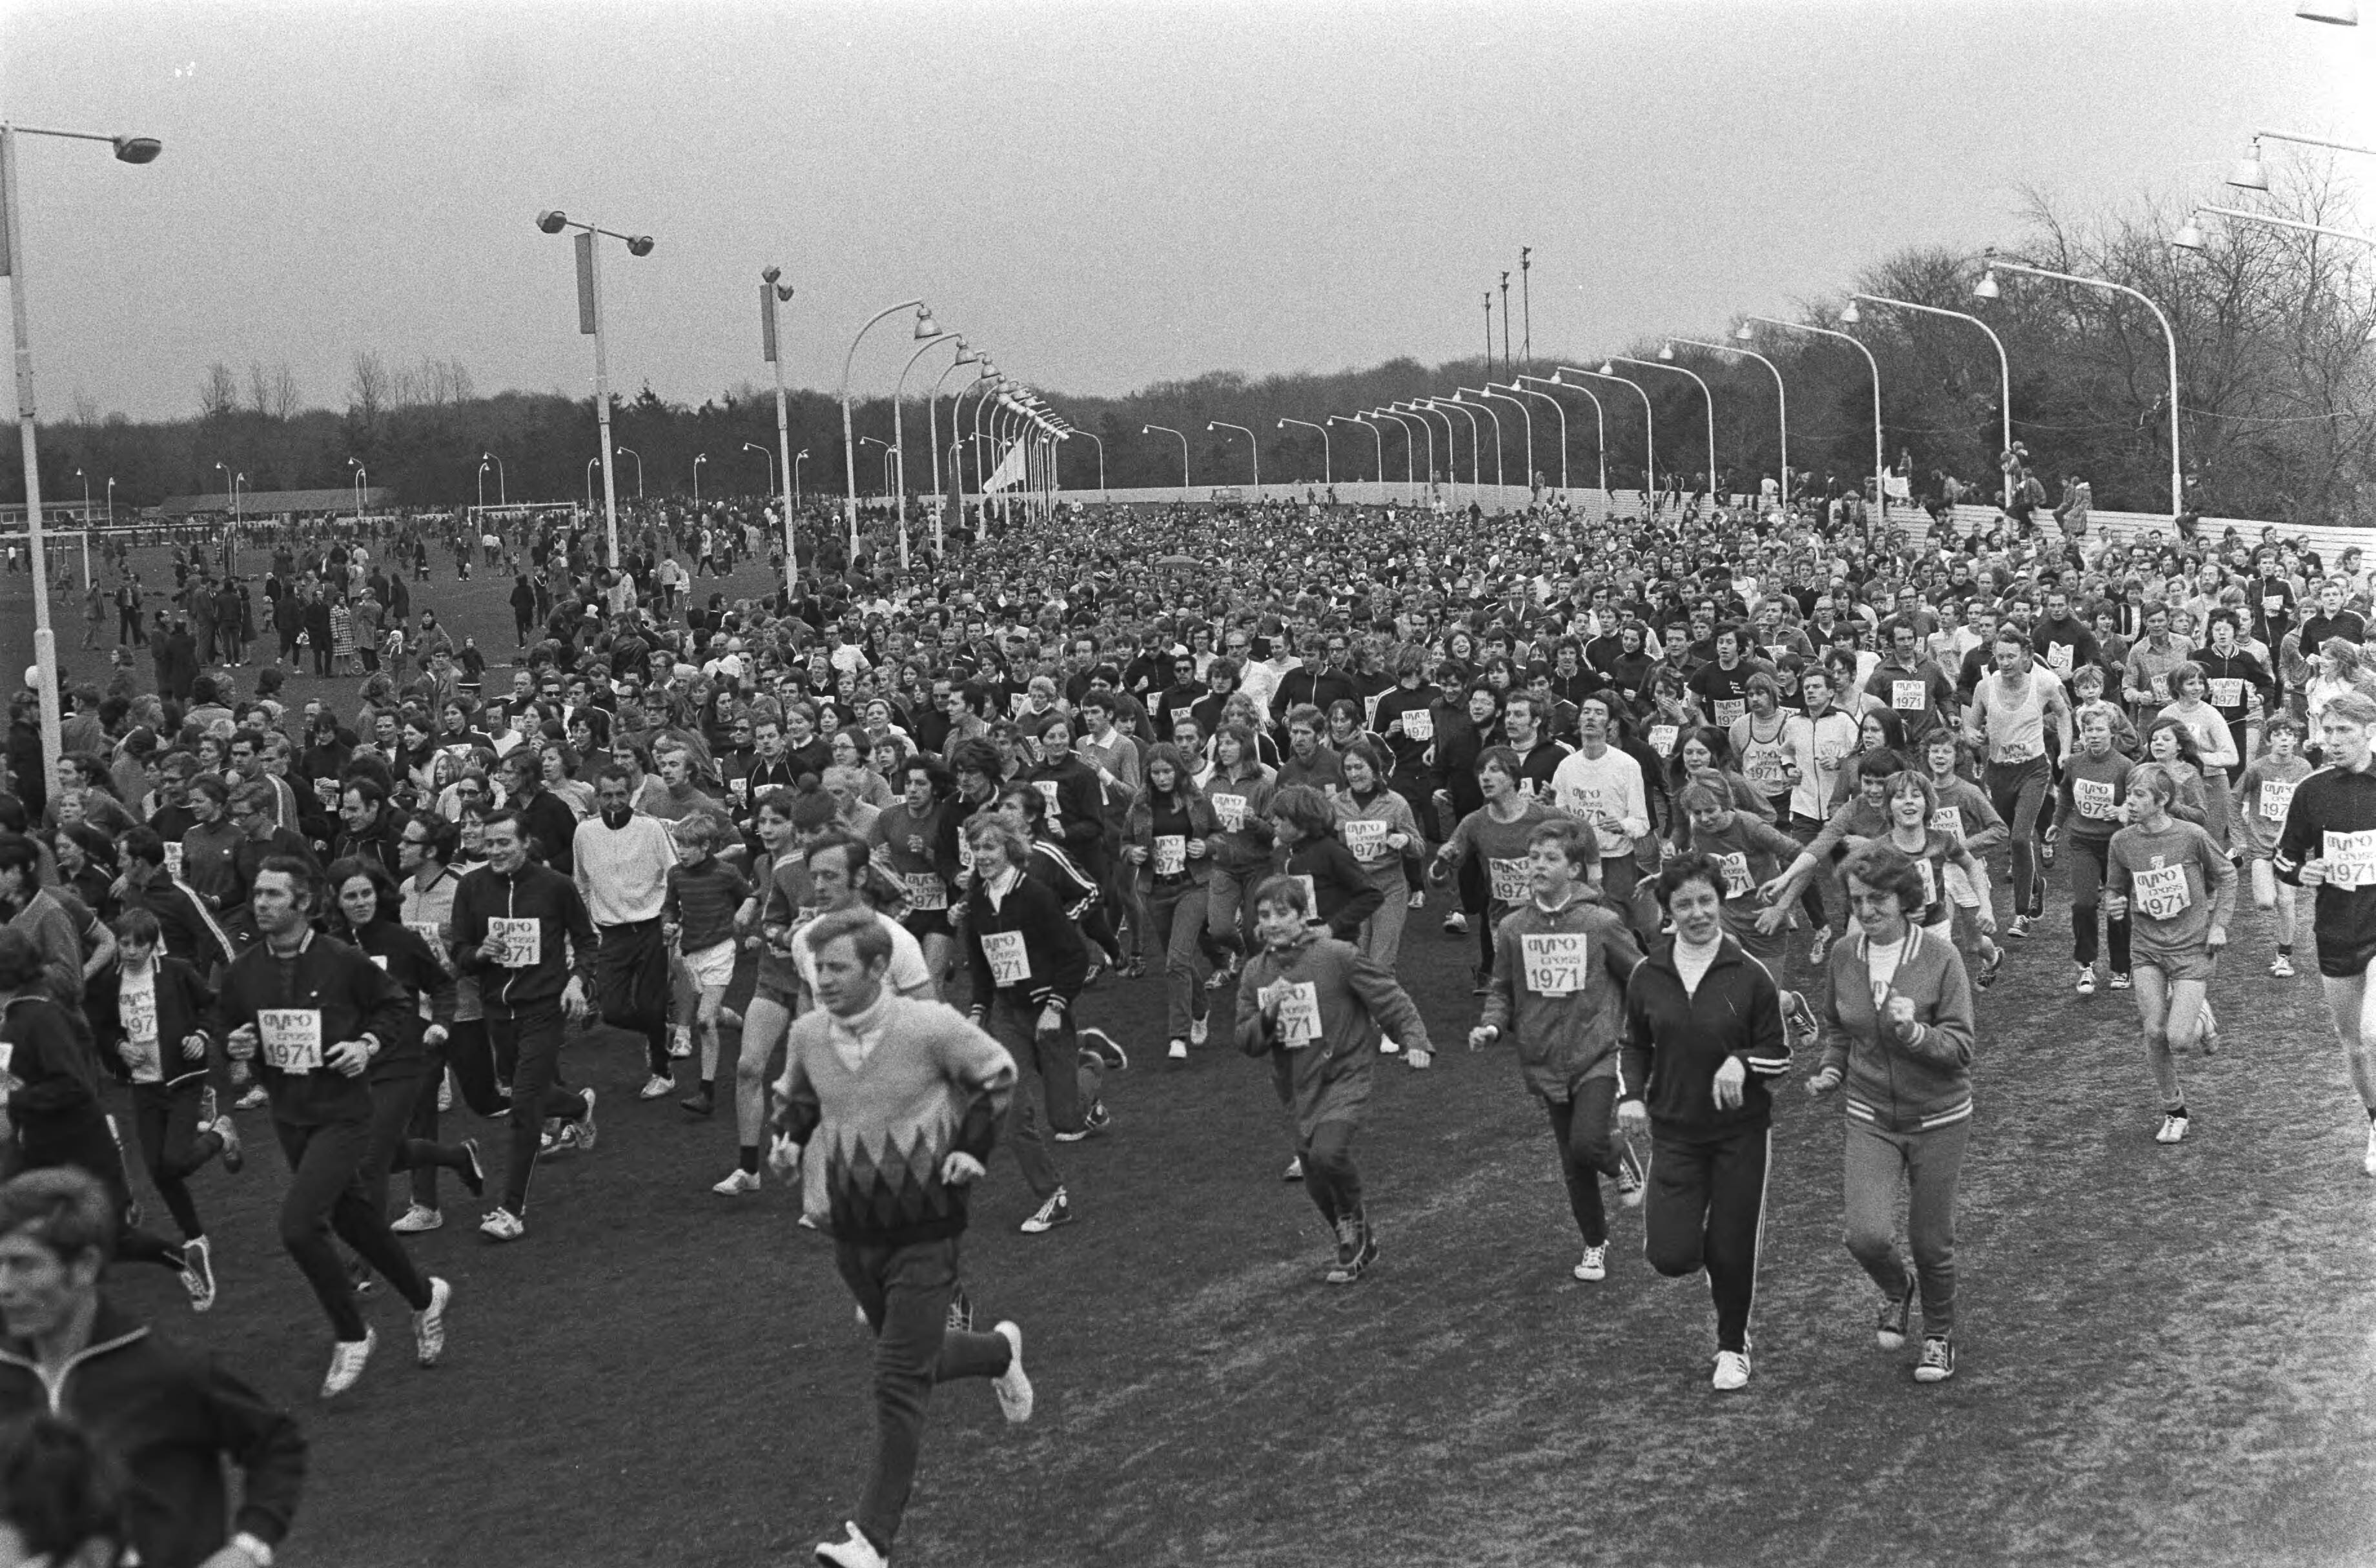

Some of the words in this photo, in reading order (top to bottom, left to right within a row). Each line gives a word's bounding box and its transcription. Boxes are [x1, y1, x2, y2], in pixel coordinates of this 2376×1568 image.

[1896, 697, 1920, 708] 1971
[2214, 695, 2238, 704] 1971
[1750, 768, 1777, 779] 1971
[2079, 800, 2105, 815] 197
[2330, 863, 2374, 882] 1971
[2143, 893, 2184, 915] 1971
[1530, 968, 1578, 988] 1971
[267, 1043, 314, 1065] 1971
